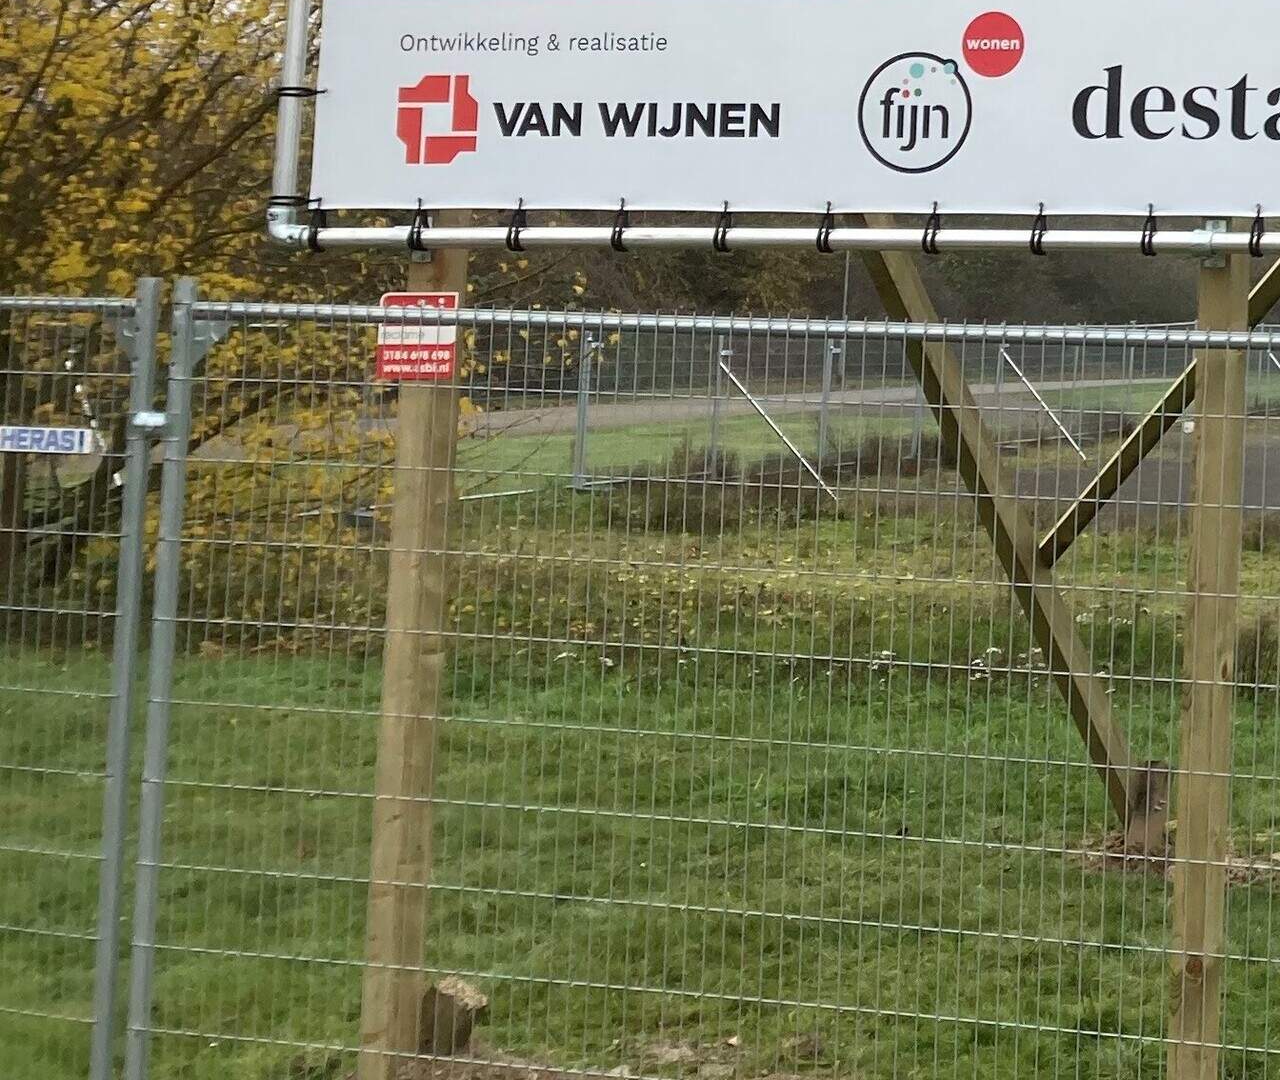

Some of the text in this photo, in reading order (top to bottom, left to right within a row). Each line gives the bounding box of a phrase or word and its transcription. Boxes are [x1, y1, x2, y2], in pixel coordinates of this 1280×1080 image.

[401, 32, 667, 56] Ontwikkeling & realisatie
[966, 38, 1021, 51] wonen
[493, 102, 780, 137] VAN WIJNEN
[880, 88, 949, 151] fijn
